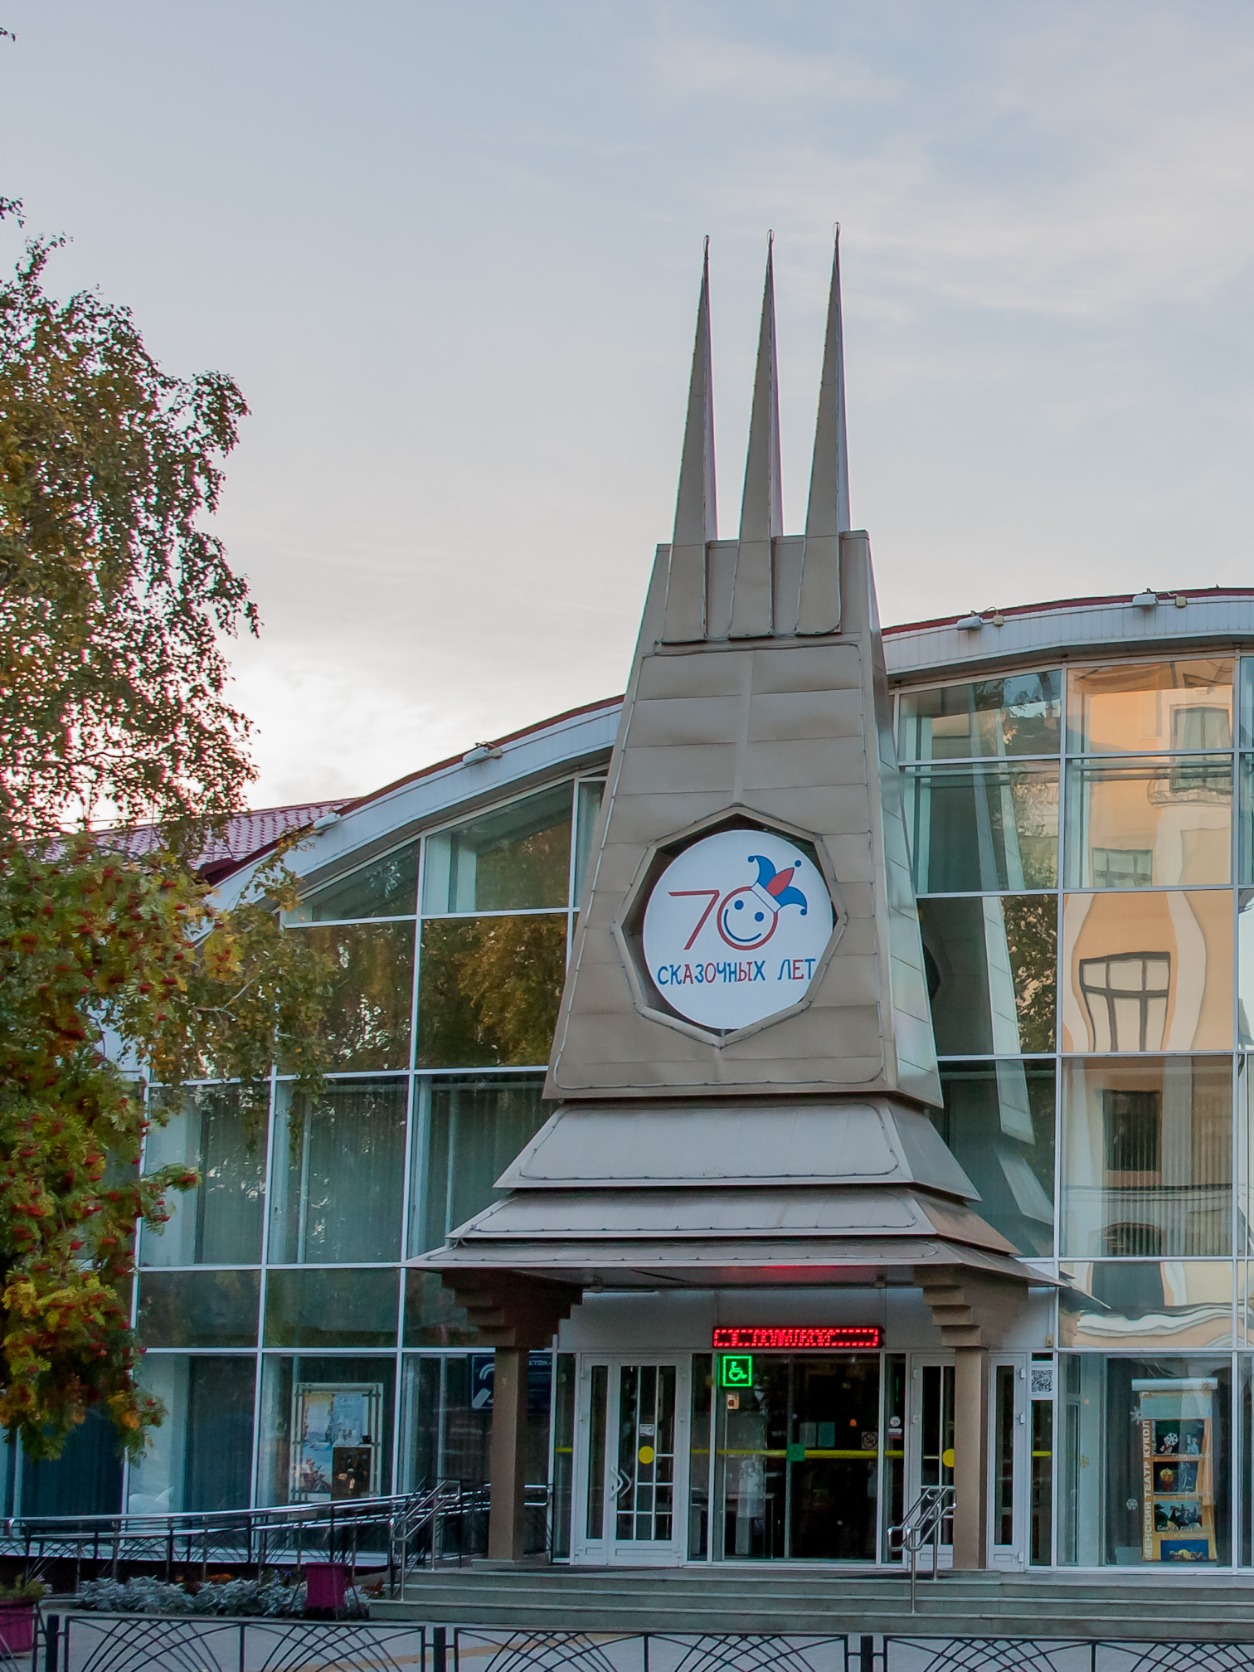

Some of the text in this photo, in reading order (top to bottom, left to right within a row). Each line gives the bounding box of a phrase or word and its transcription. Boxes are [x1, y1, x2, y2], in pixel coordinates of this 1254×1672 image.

[668, 886, 779, 951] 70
[657, 958, 816, 985] СКАЗОЧНЫХ ЛЕТ
